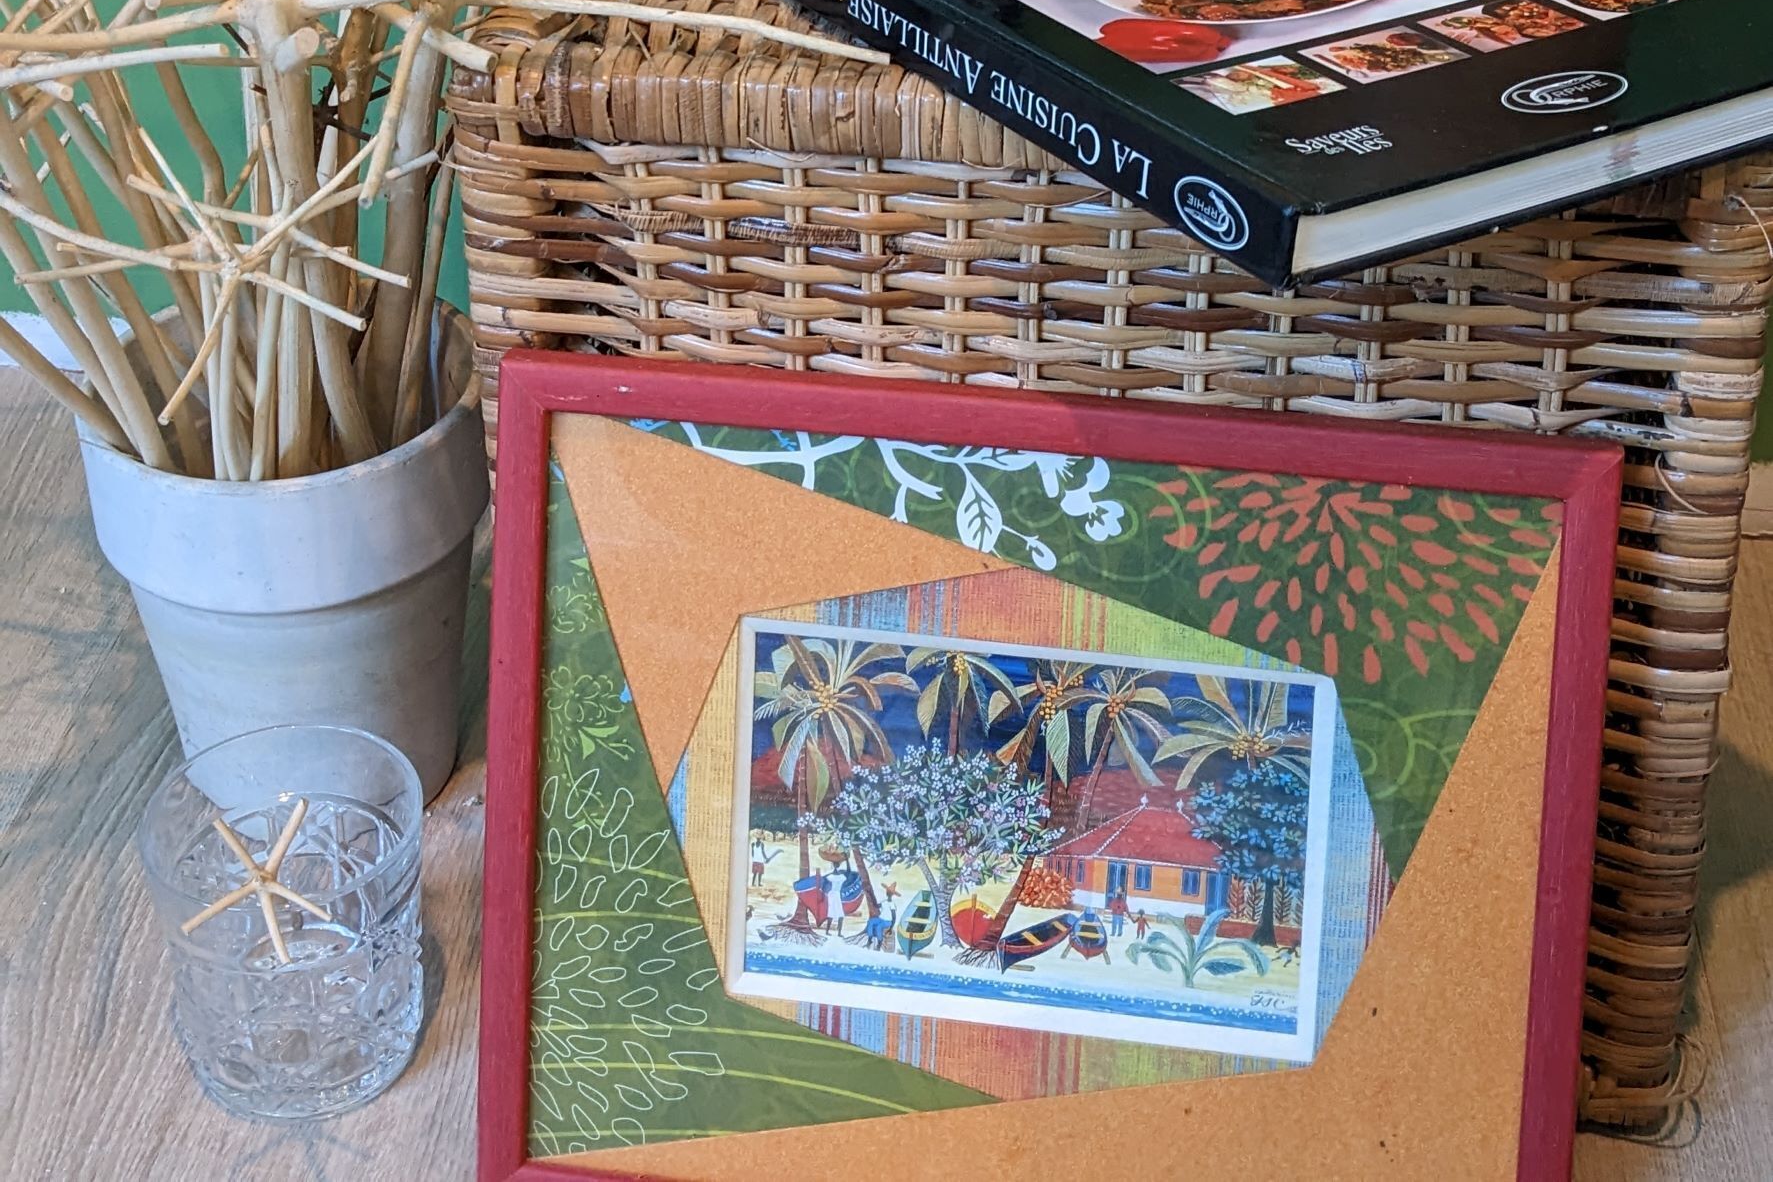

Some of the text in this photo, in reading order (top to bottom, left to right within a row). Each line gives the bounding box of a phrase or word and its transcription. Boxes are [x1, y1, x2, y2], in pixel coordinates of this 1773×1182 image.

[990, 71, 1101, 166] CUISINE
[1285, 125, 1380, 154] Saveurs
[1111, 139, 1153, 200] LA
